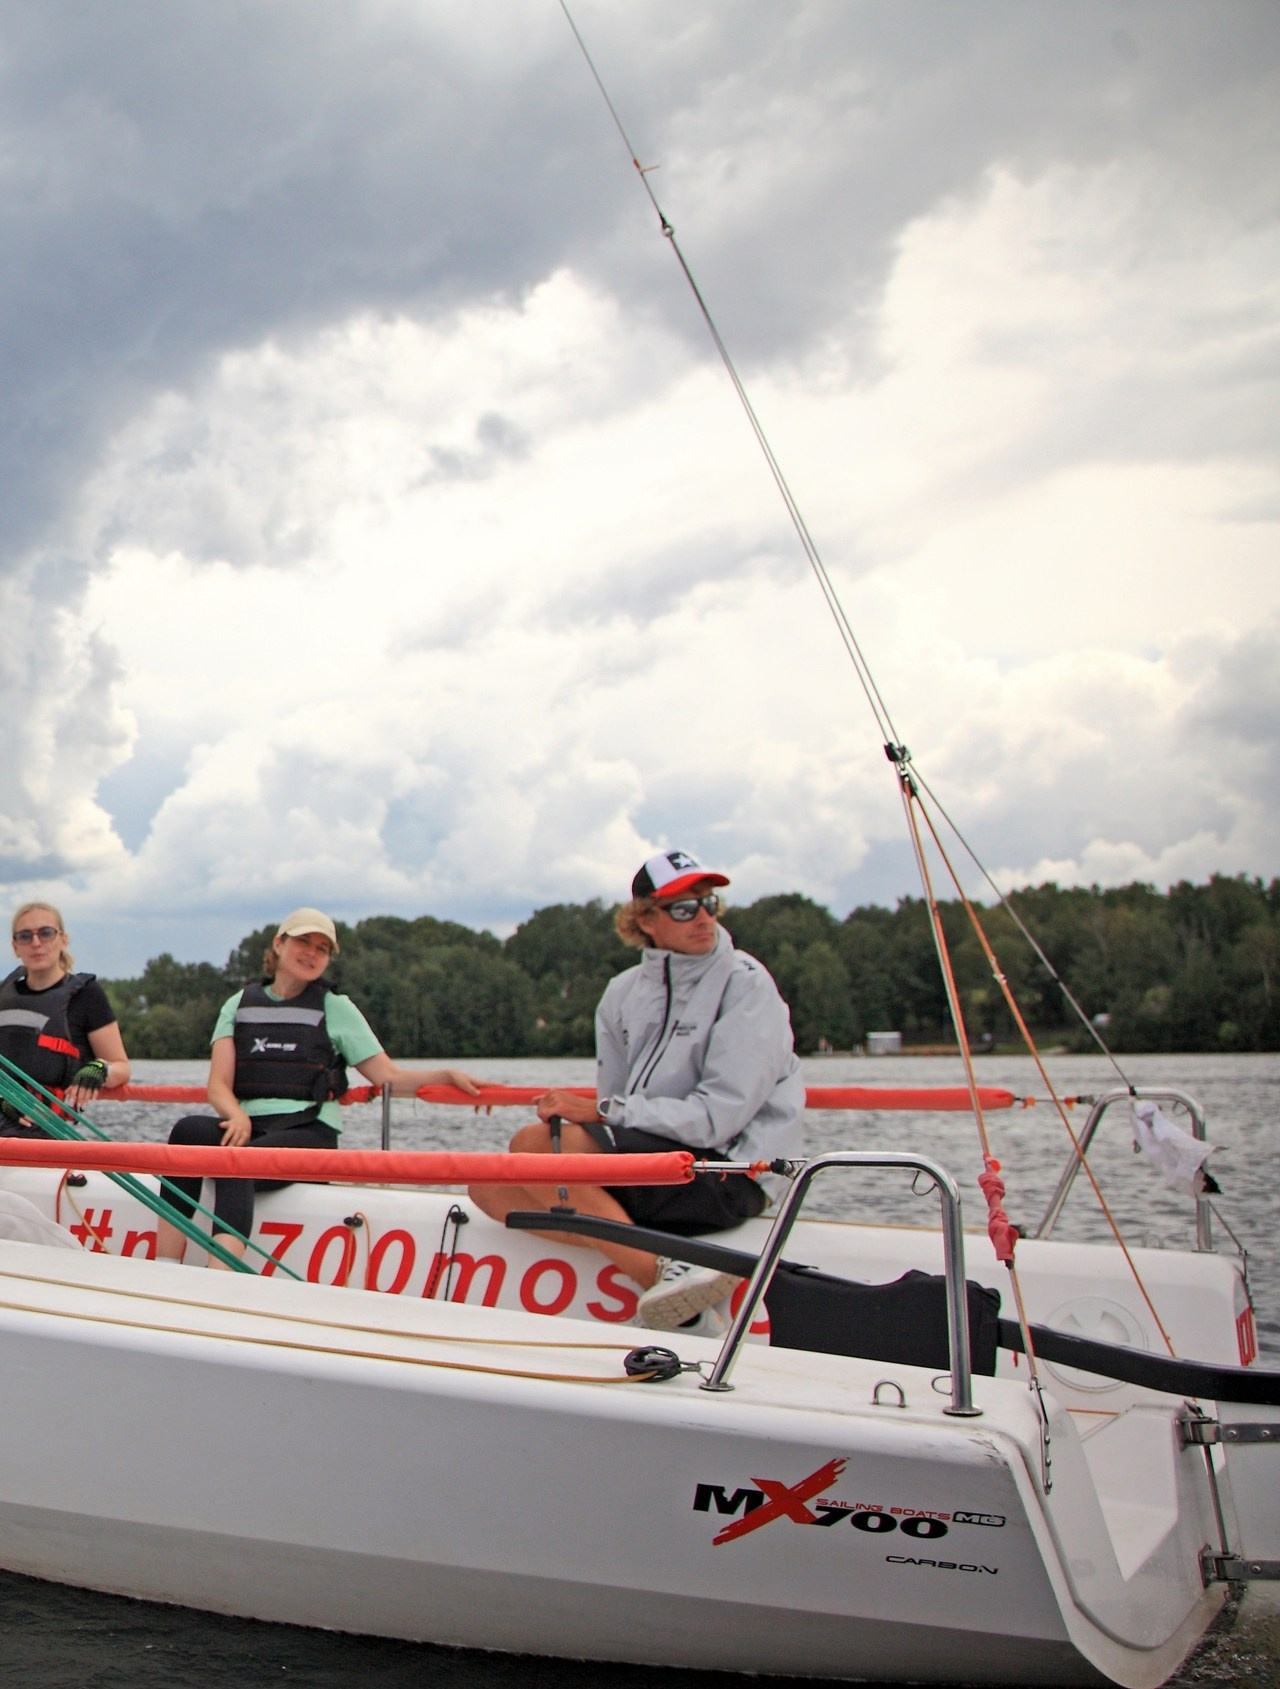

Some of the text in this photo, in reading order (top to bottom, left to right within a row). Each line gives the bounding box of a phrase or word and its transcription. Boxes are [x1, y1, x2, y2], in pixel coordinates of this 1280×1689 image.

[815, 1498, 951, 1521] SAILING BOATS
[885, 1555, 999, 1575] CARBON
